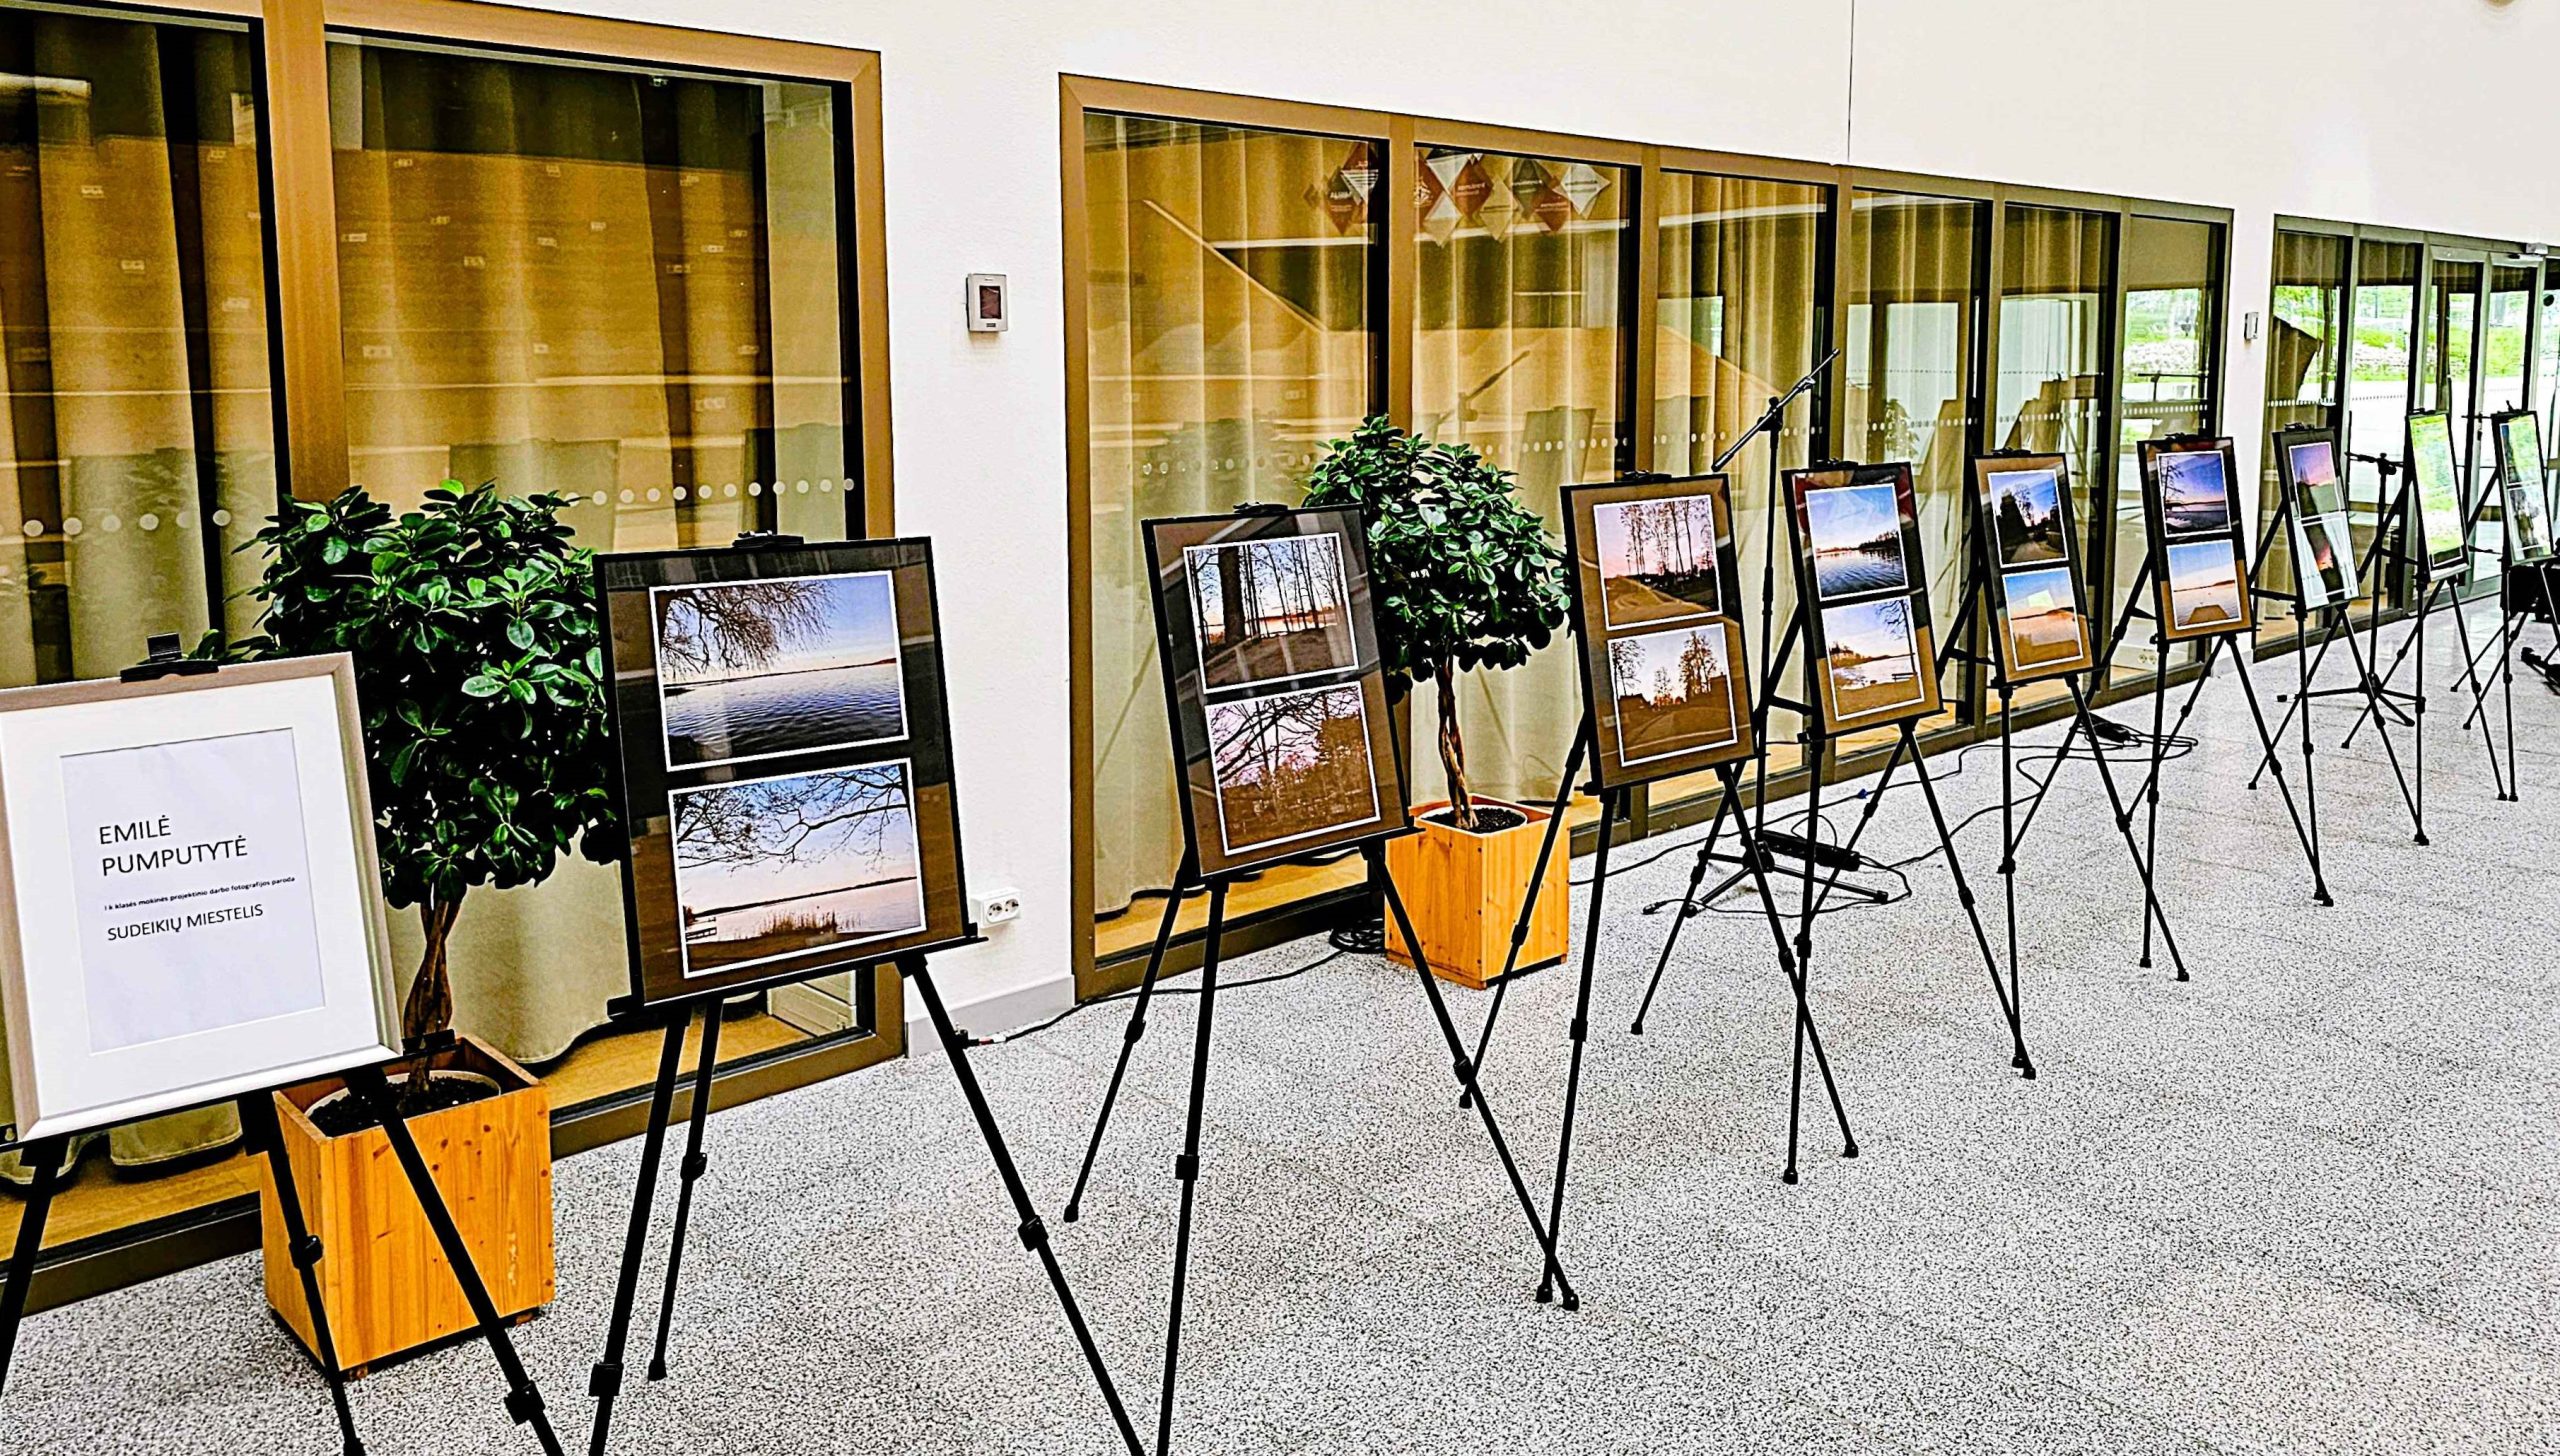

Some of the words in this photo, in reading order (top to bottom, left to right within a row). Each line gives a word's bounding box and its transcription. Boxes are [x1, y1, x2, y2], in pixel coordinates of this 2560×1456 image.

[99, 814, 172, 845] EMILĖ
[102, 834, 248, 877] PUMPUTYTĖ
[115, 901, 137, 910] klasės
[138, 896, 169, 906] mokinės
[170, 889, 208, 902] projektinio
[209, 886, 231, 895] darbo
[231, 880, 271, 891] fotografijos
[272, 876, 296, 886] paroda
[107, 916, 182, 942] SUDEIKIŲ
[186, 903, 264, 928] MIESTELIS
